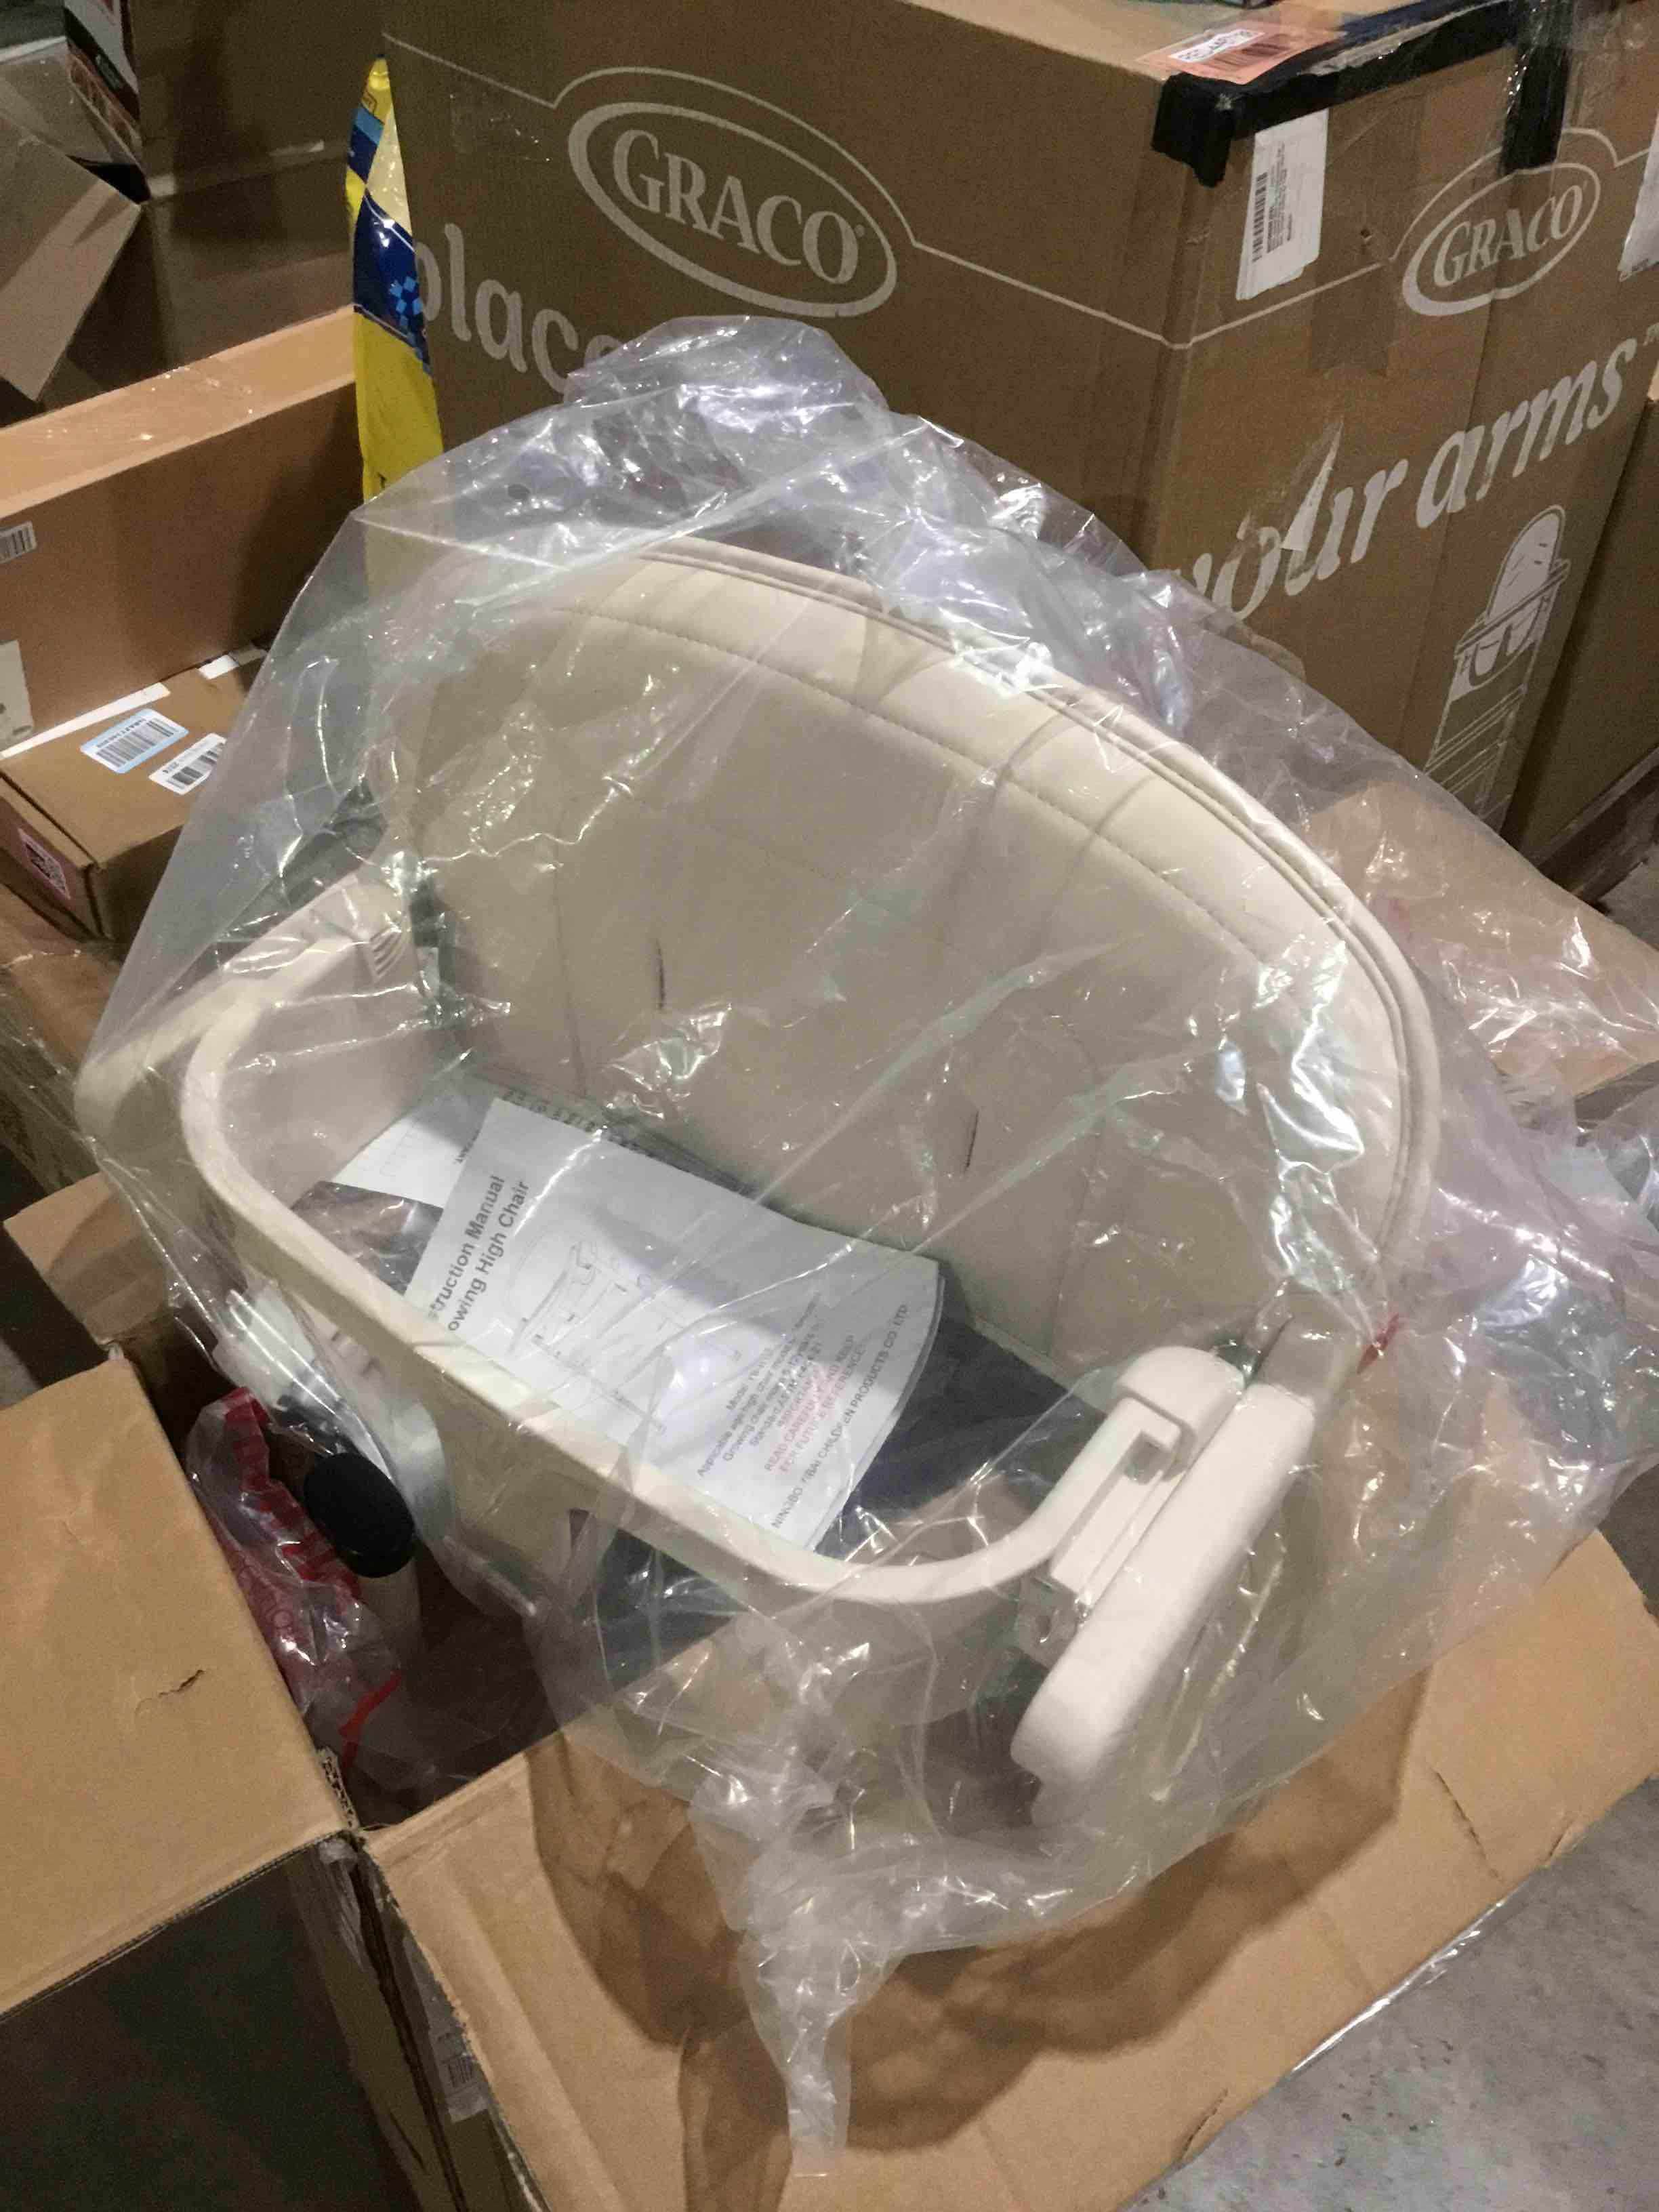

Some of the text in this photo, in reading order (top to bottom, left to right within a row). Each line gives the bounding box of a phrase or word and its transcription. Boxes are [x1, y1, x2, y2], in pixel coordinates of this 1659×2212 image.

[613, 129, 858, 285] GRACO
[1433, 185, 1582, 287] GRACO
[447, 1181, 529, 1331] owing High Chair
[464, 1174, 505, 1240] Manual
[849, 1350, 888, 1408] PRODUCTS
